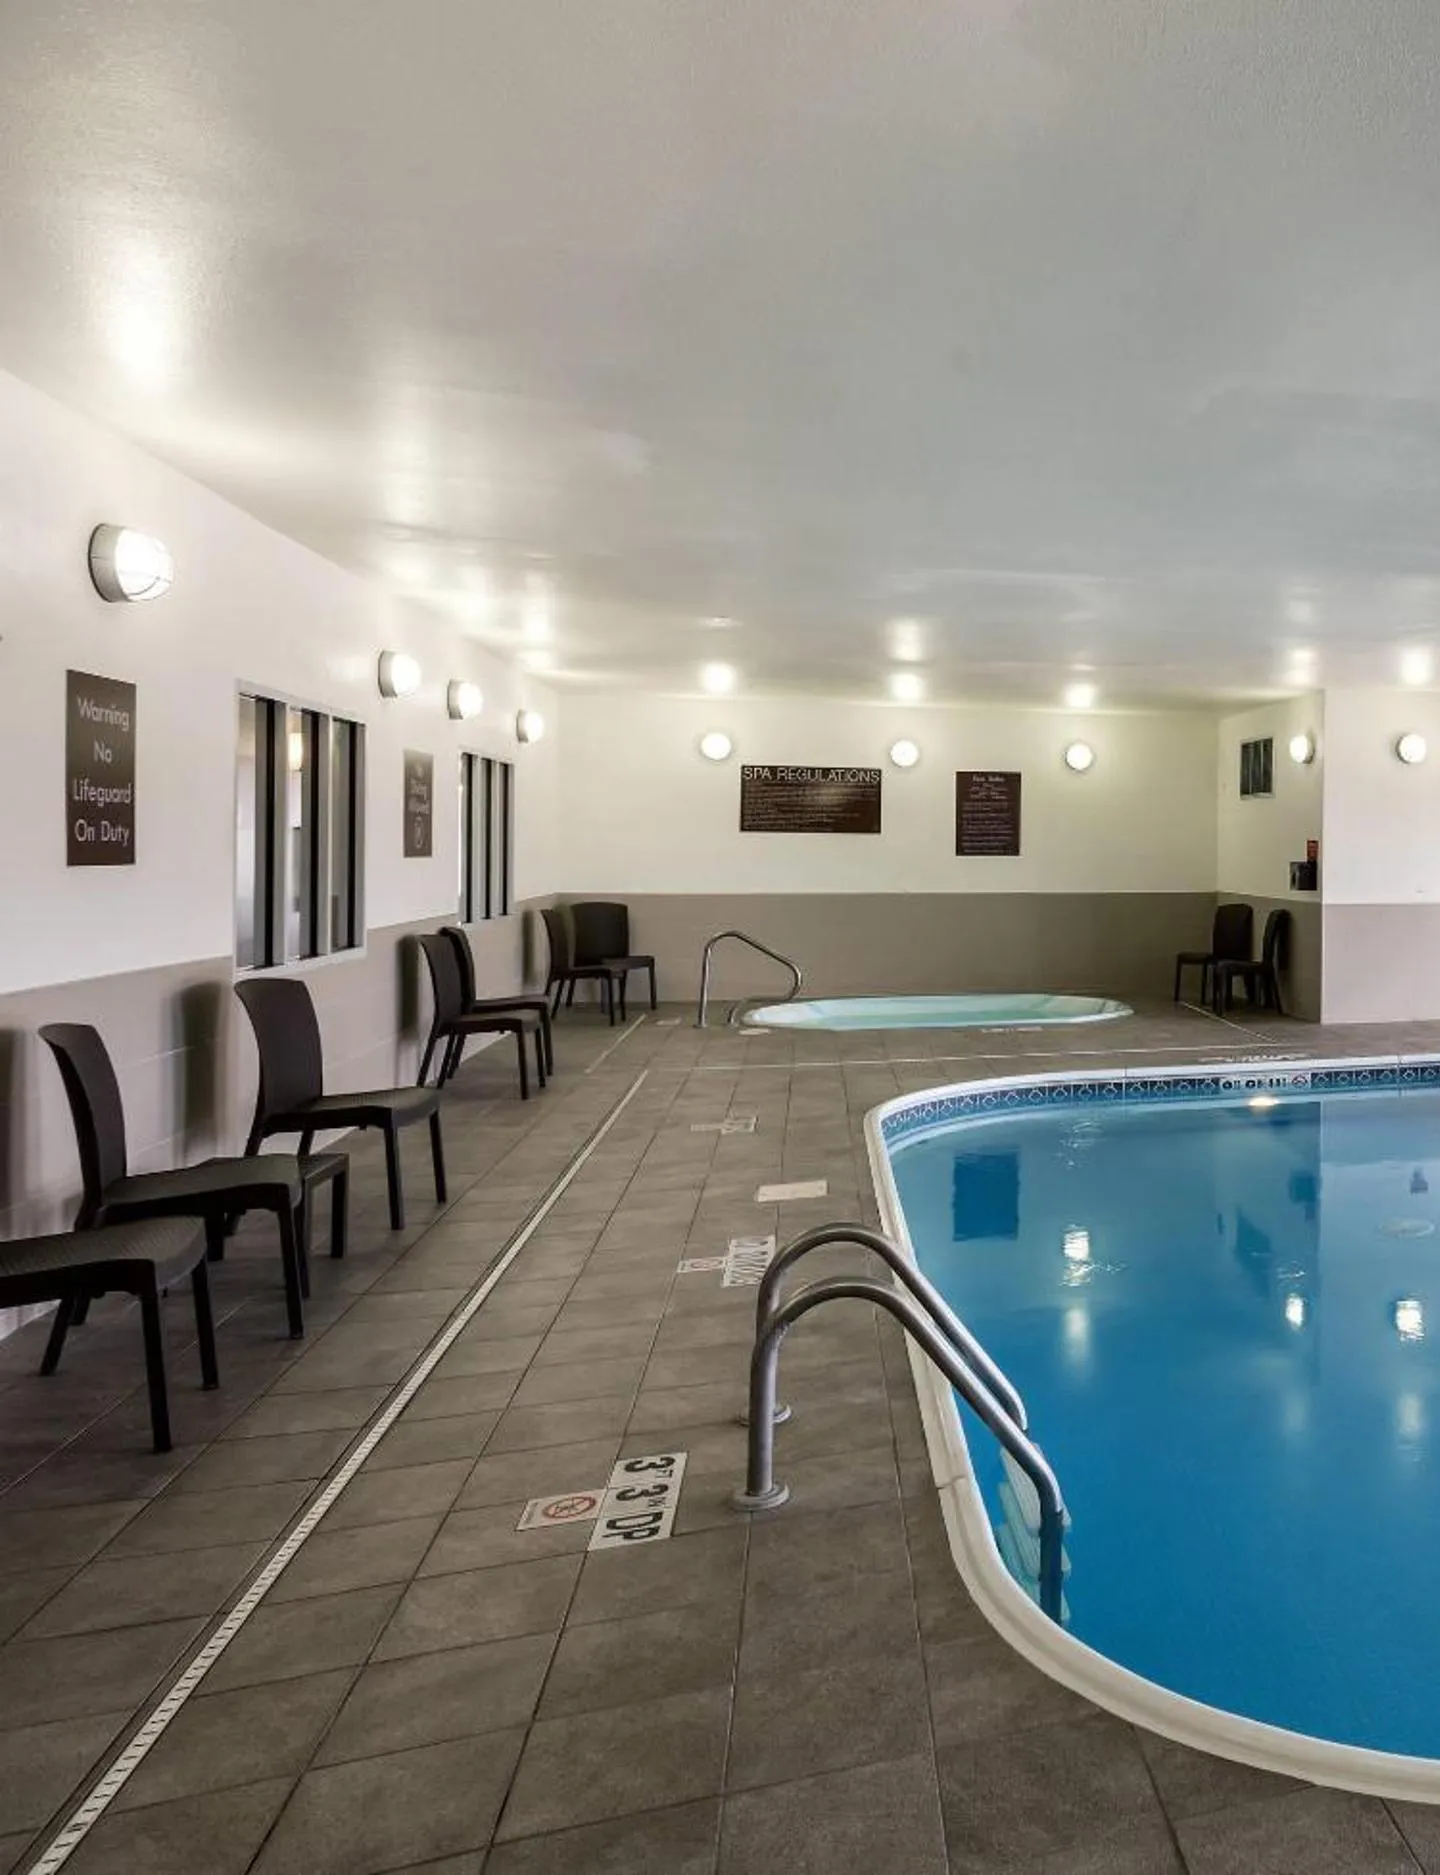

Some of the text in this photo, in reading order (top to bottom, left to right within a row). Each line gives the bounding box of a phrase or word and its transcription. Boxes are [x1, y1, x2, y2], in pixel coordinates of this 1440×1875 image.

[76, 698, 130, 731] Warning
[93, 740, 113, 764] No
[743, 767, 880, 783] SPA REGULATIONS
[73, 777, 132, 807] Lifeguard
[74, 818, 130, 846] On Duty
[602, 1512, 664, 1539] DP
